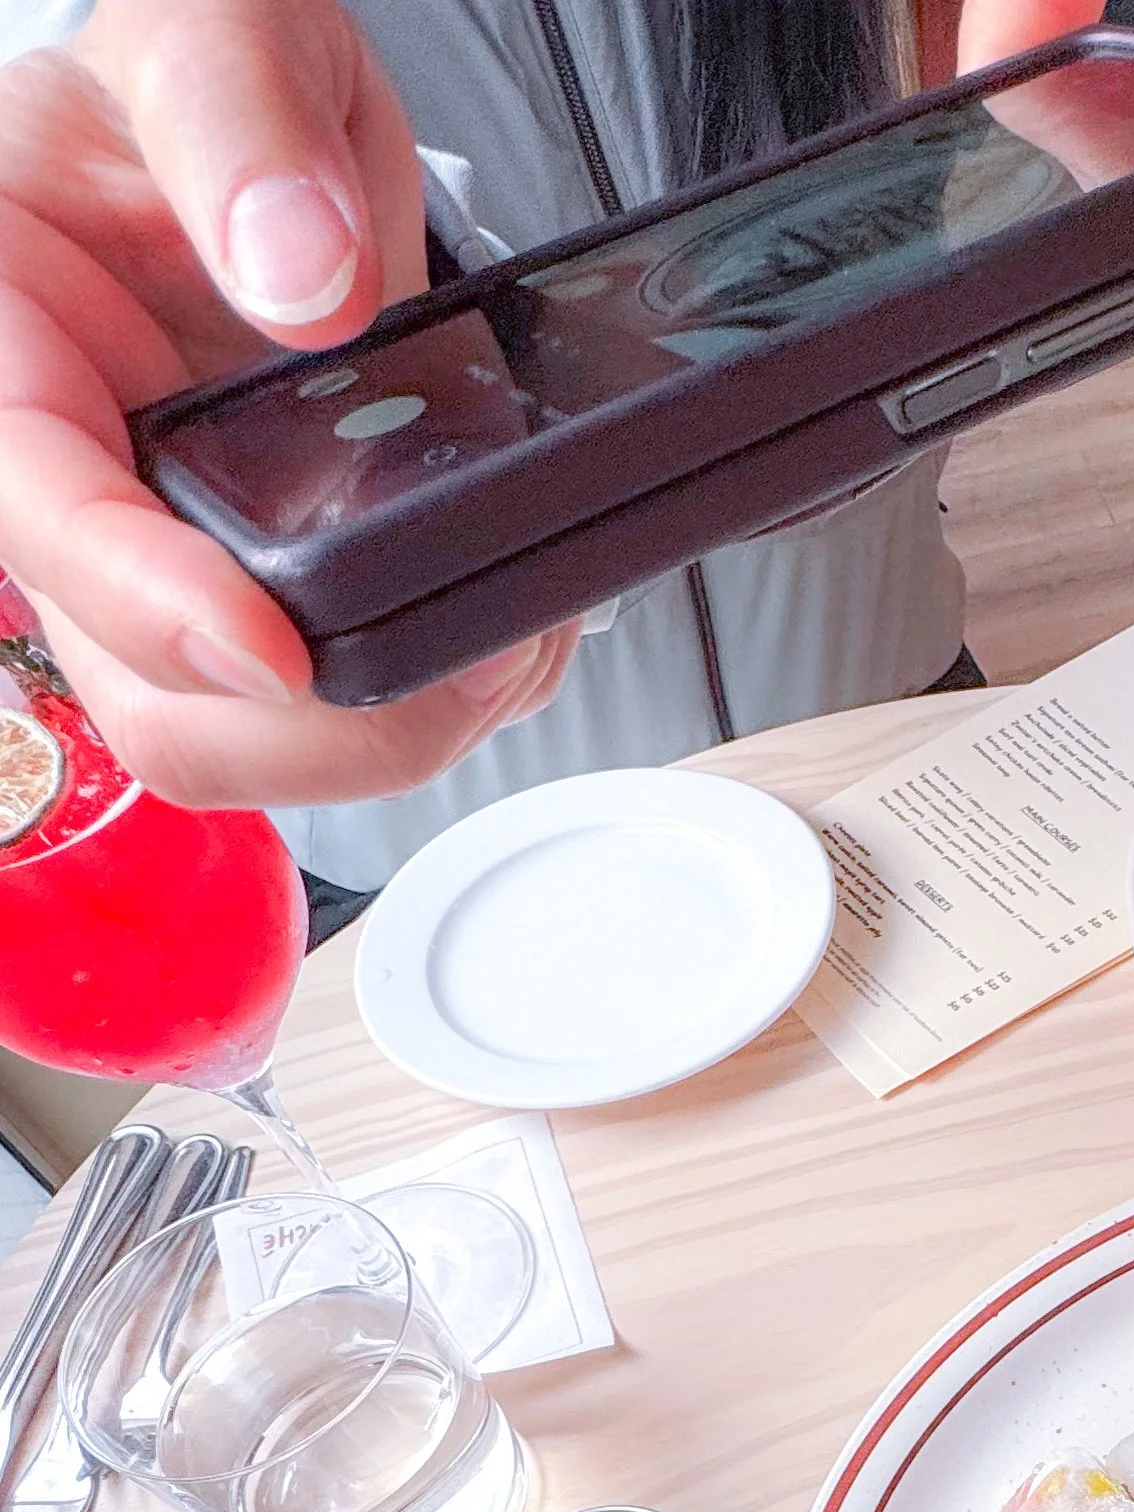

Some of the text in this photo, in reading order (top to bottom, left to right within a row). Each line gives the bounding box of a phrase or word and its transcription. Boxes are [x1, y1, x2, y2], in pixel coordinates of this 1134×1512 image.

[1021, 806, 1081, 853] MAIN COURSES
[915, 880, 953, 913] DESSERTS
